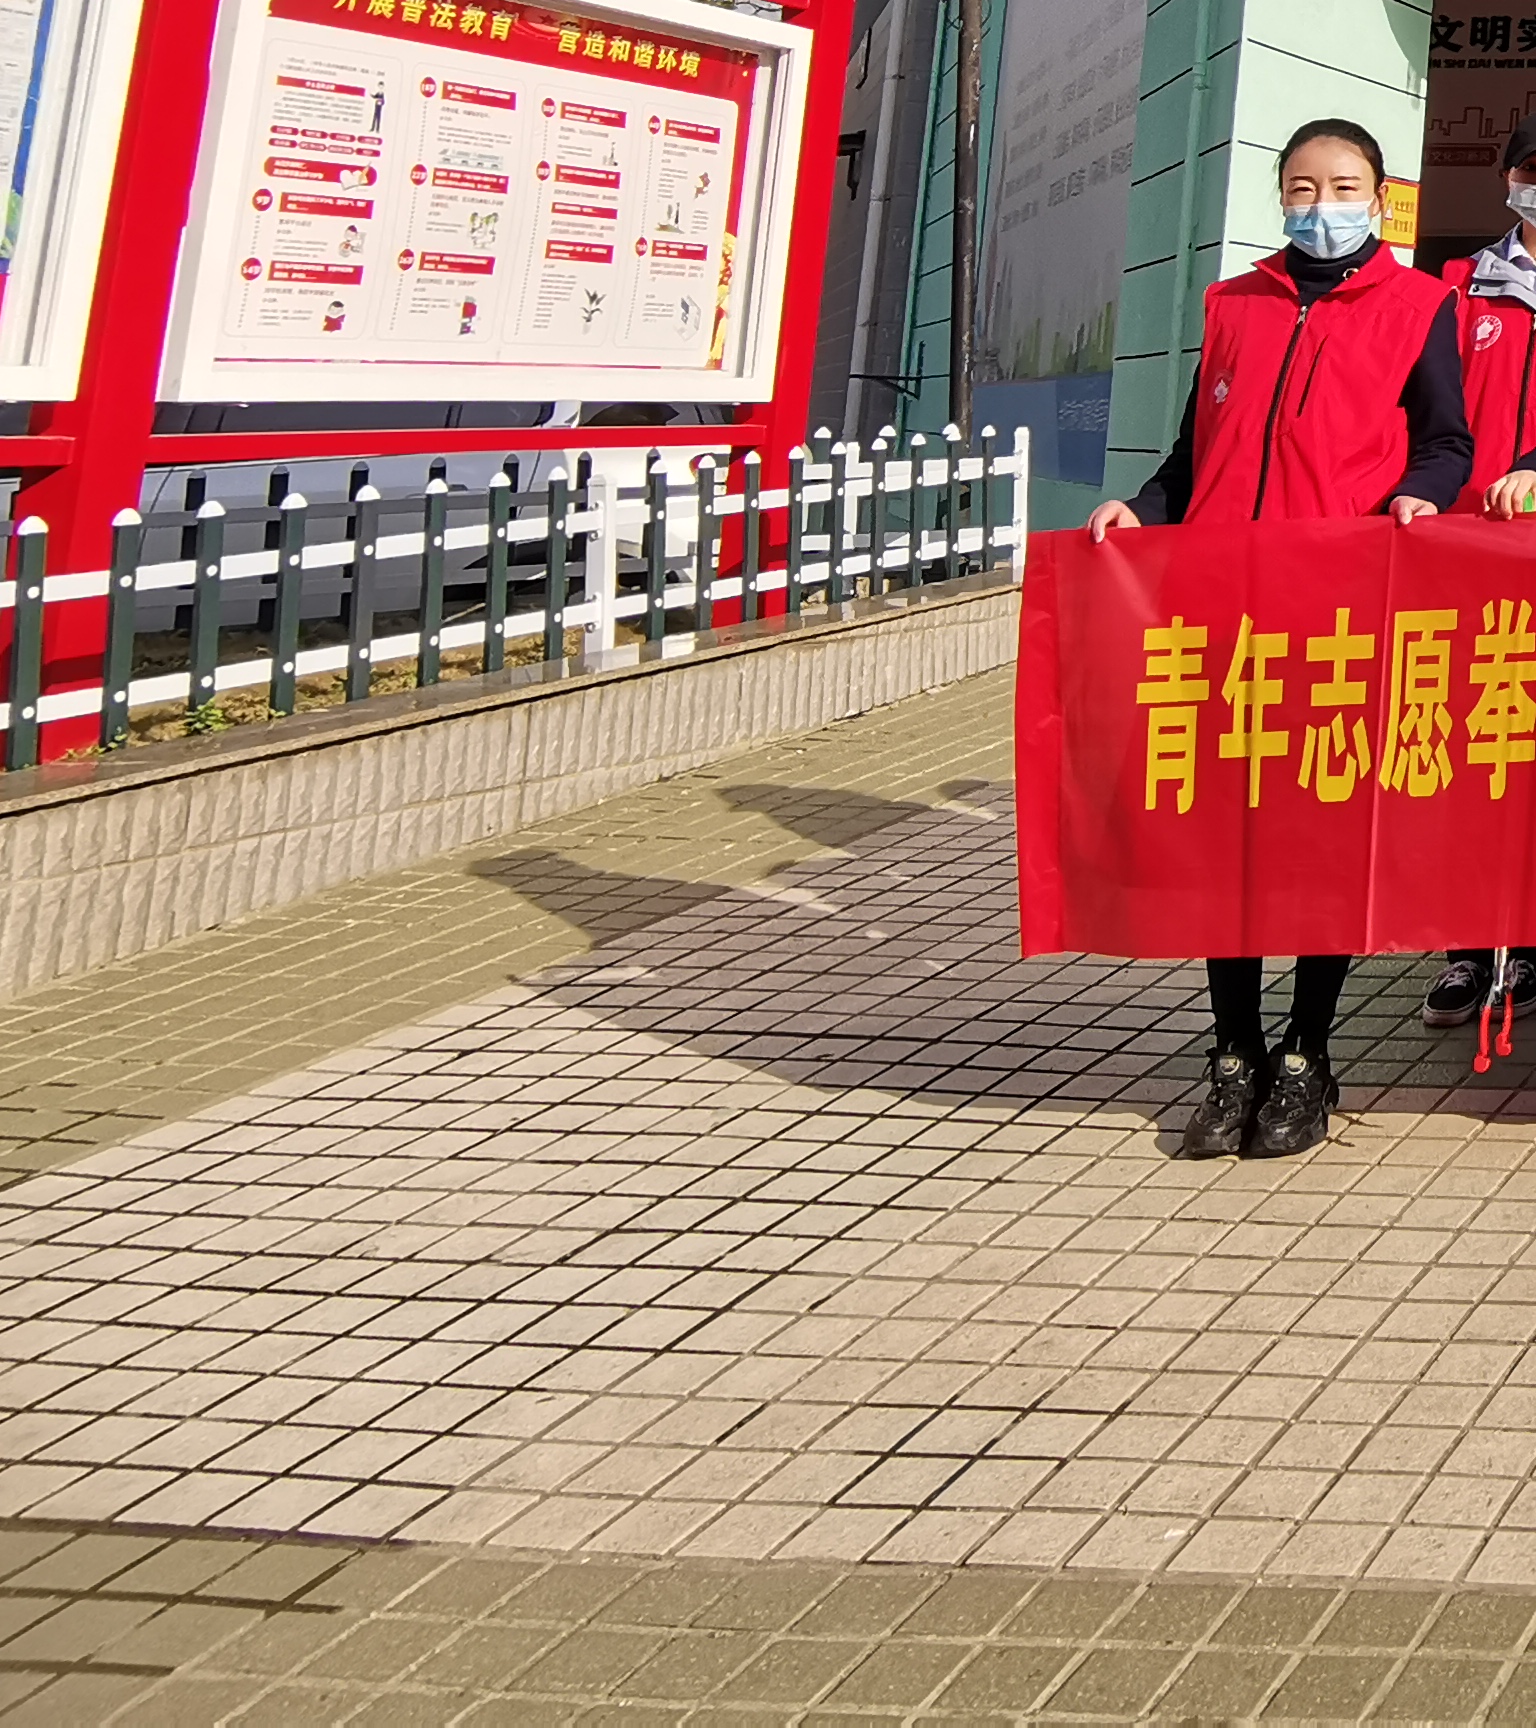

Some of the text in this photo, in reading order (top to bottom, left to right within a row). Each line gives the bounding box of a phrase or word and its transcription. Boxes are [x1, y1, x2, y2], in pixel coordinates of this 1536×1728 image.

[558, 21, 701, 78] 营造和谐环境
